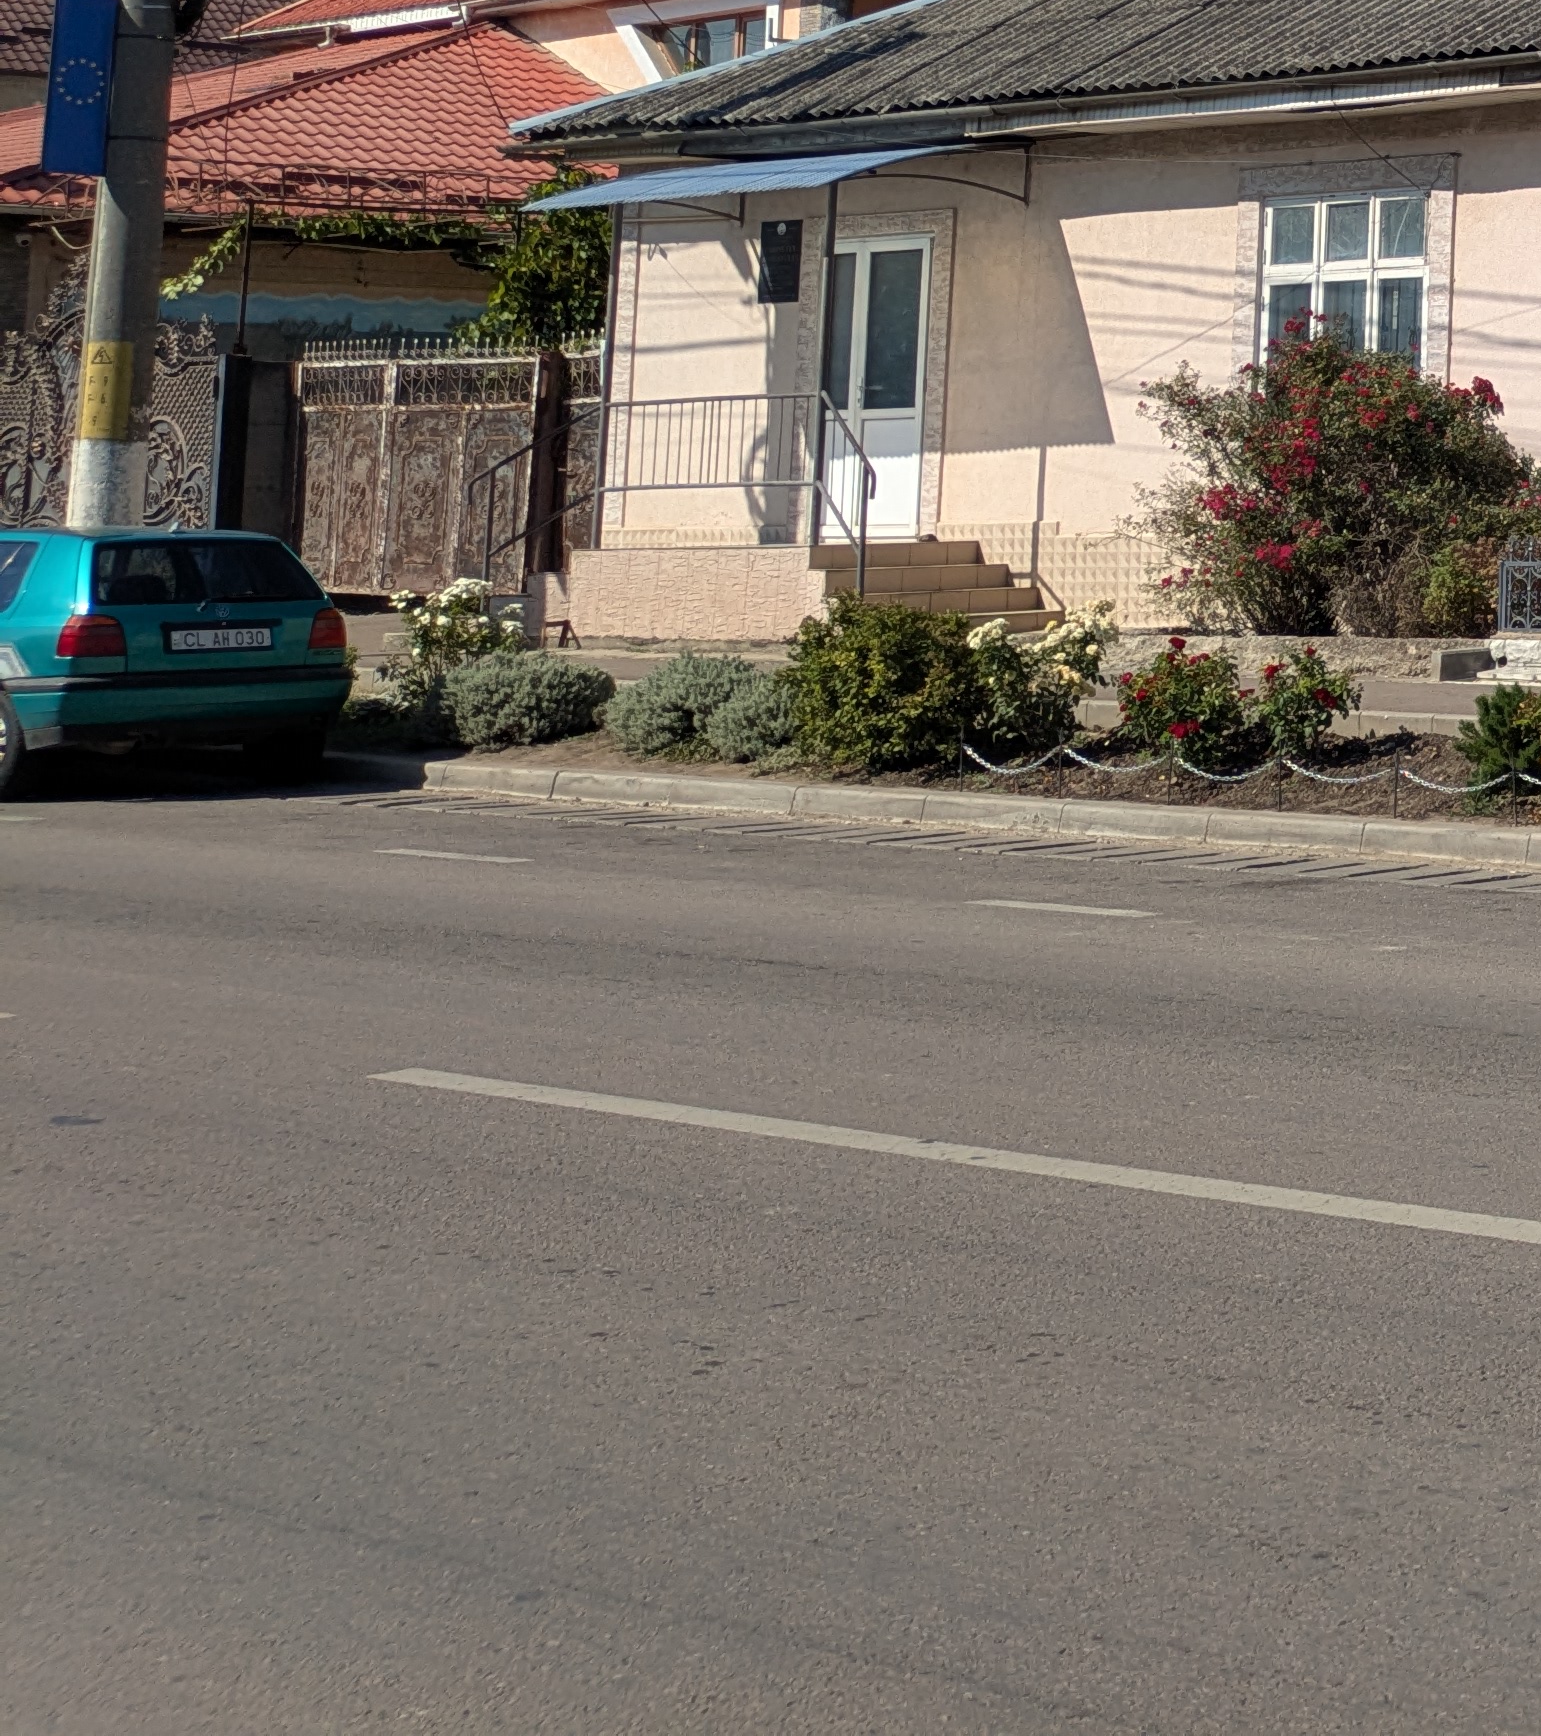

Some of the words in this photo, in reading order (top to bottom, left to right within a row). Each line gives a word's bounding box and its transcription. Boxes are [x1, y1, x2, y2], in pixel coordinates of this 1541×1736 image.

[183, 632, 206, 648] CL
[213, 631, 230, 647] AH
[235, 630, 265, 646] 030
